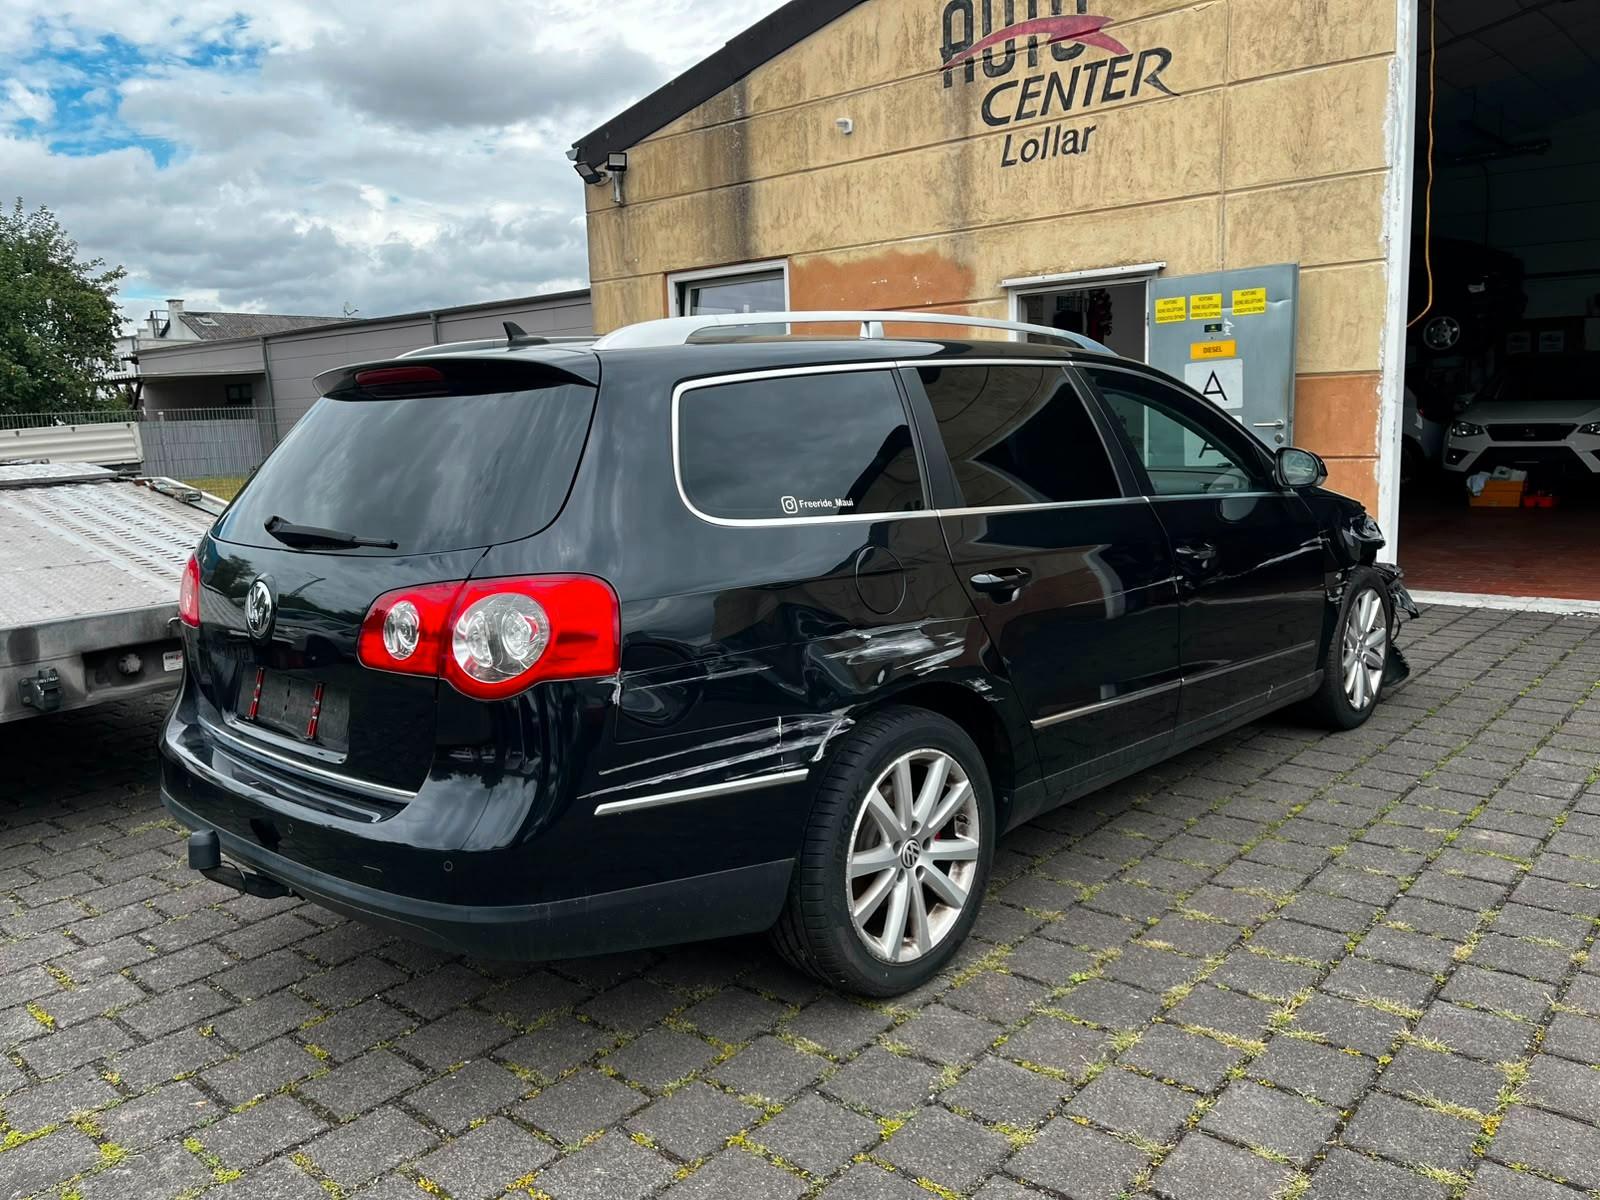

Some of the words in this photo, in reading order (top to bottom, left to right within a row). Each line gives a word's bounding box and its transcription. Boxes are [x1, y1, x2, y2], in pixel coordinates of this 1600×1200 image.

[981, 47, 1181, 127] CENTER
[1000, 124, 1097, 168] Lollar
[1202, 345, 1223, 354] DIESEL
